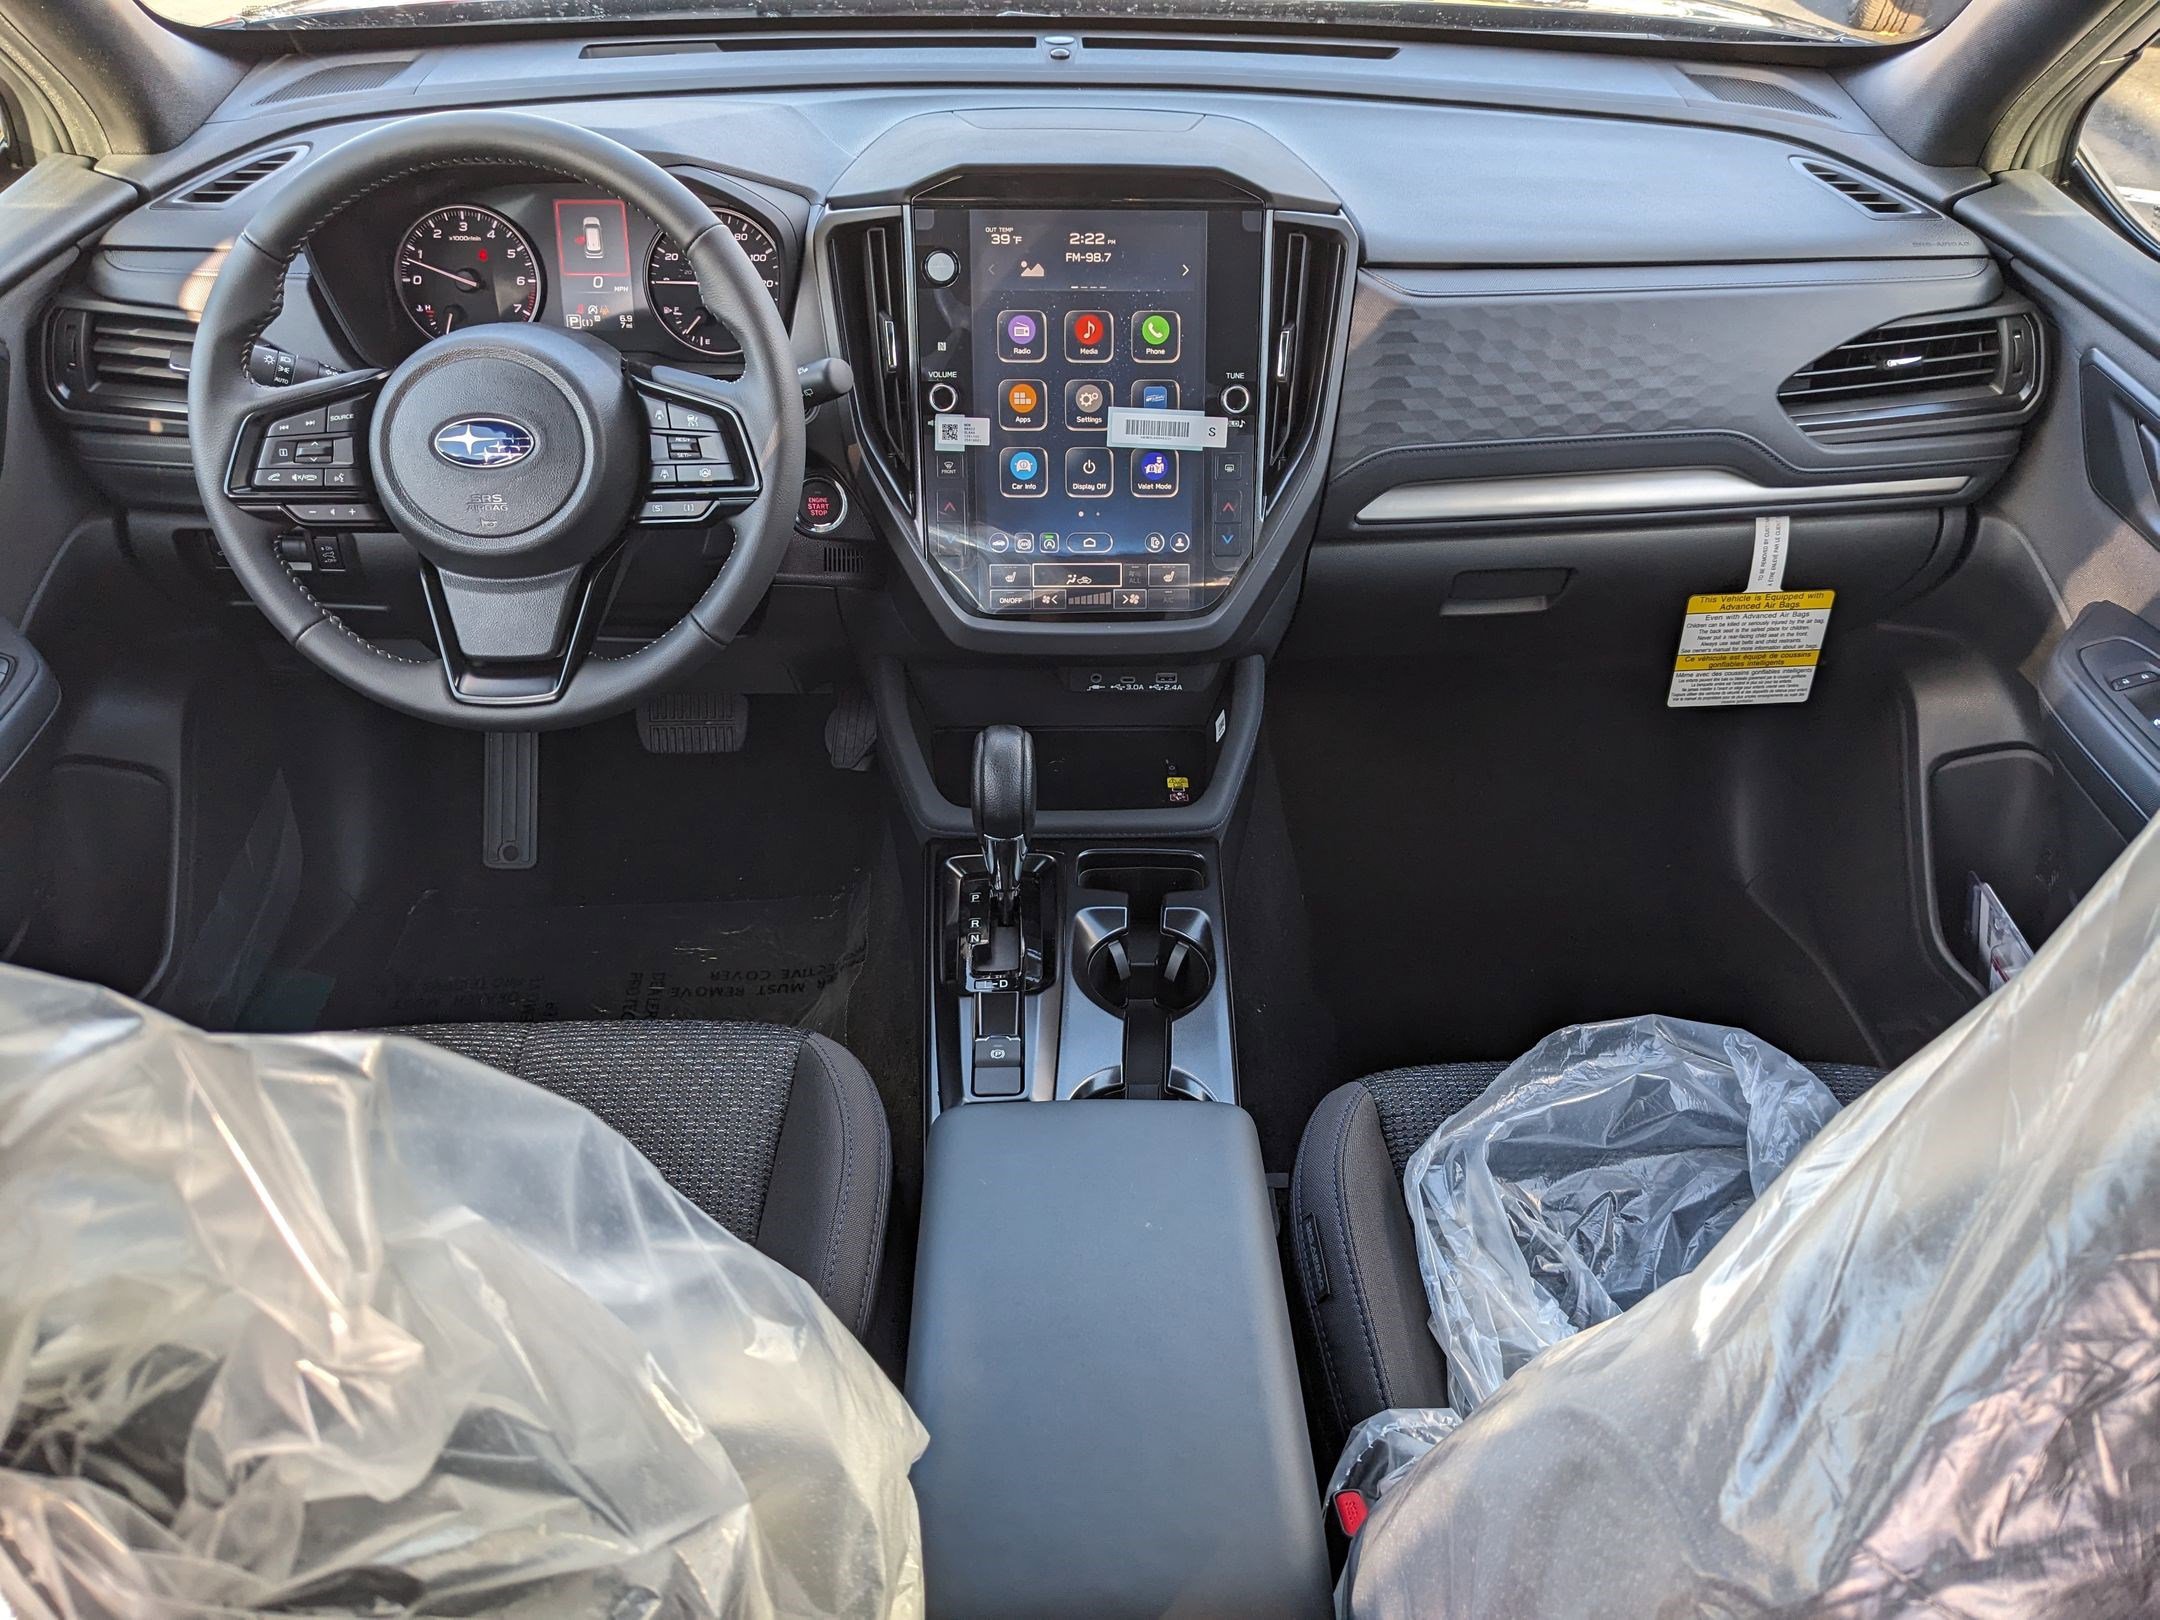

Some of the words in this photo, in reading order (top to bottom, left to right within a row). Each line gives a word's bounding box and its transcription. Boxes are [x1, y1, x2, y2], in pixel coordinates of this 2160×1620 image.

[459, 222, 468, 231] 3
[433, 230, 442, 238] 2
[487, 231, 495, 239] 4
[1069, 233, 1105, 244] 2:22
[991, 234, 1010, 244] 39
[417, 250, 422, 258] 1
[507, 249, 516, 258] 5
[1066, 253, 1111, 262] FM-98.7
[413, 275, 422, 284] 0
[517, 276, 525, 285] 6
[593, 276, 603, 288] 0
[514, 304, 522, 313] 7
[330, 413, 354, 422] SOURCE
[1208, 427, 1216, 437] S
[471, 494, 502, 503] SRS
[466, 504, 508, 512] AIRBAG
[1765, 593, 1804, 601] Equipped
[710, 970, 771, 982] COVER
[671, 985, 745, 998] REMOVE
[756, 983, 805, 996] MUST
